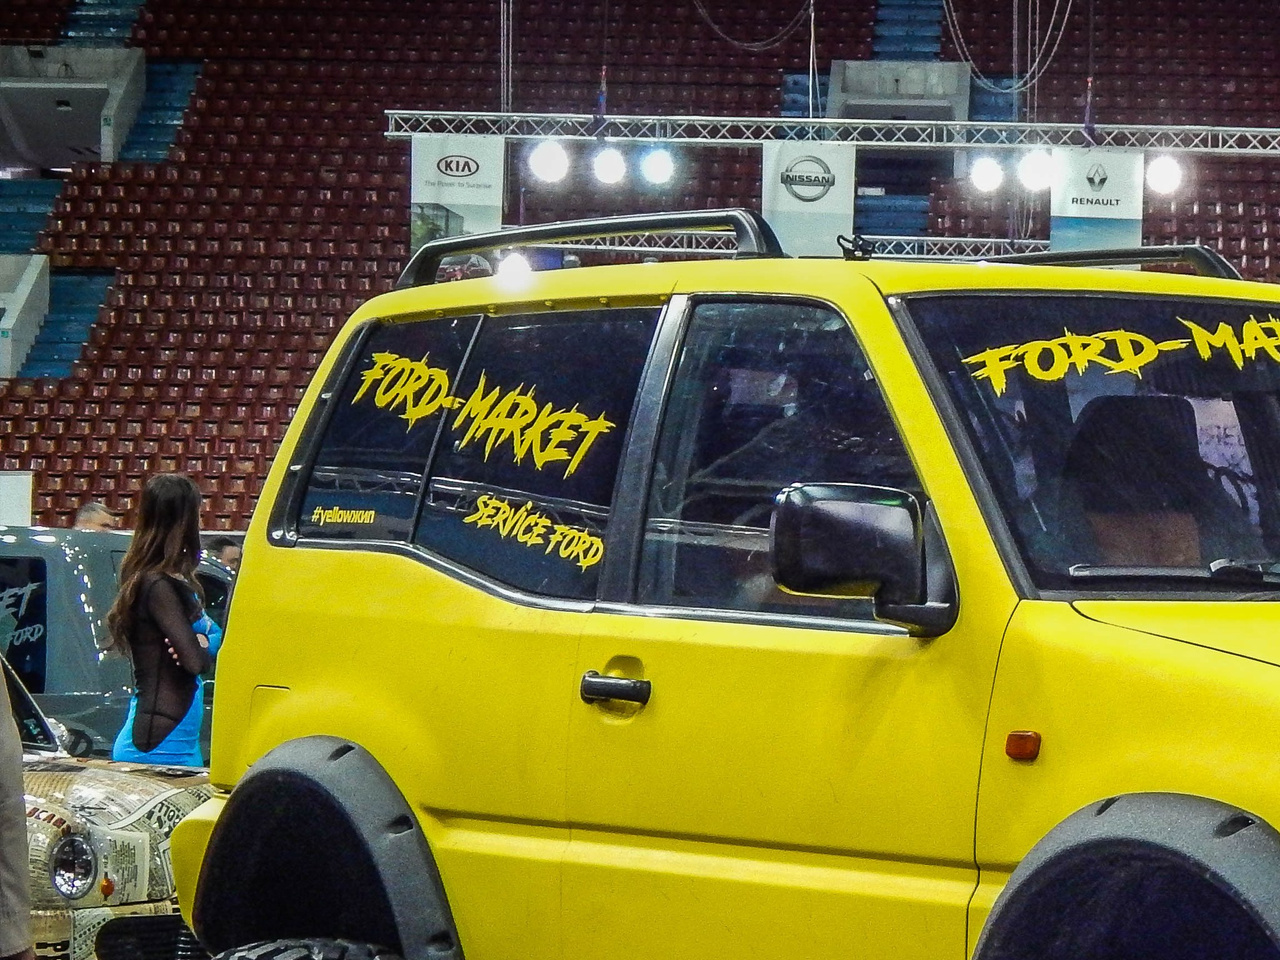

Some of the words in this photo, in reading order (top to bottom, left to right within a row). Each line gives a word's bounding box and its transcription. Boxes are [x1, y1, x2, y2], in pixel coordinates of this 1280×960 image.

[444, 160, 472, 173] KIA
[785, 174, 830, 184] NISSAN
[1071, 197, 1121, 206] RENAULT
[351, 350, 617, 480] FORD-MARKET
[311, 505, 375, 526] #yellowжип
[545, 524, 604, 573] FORD
